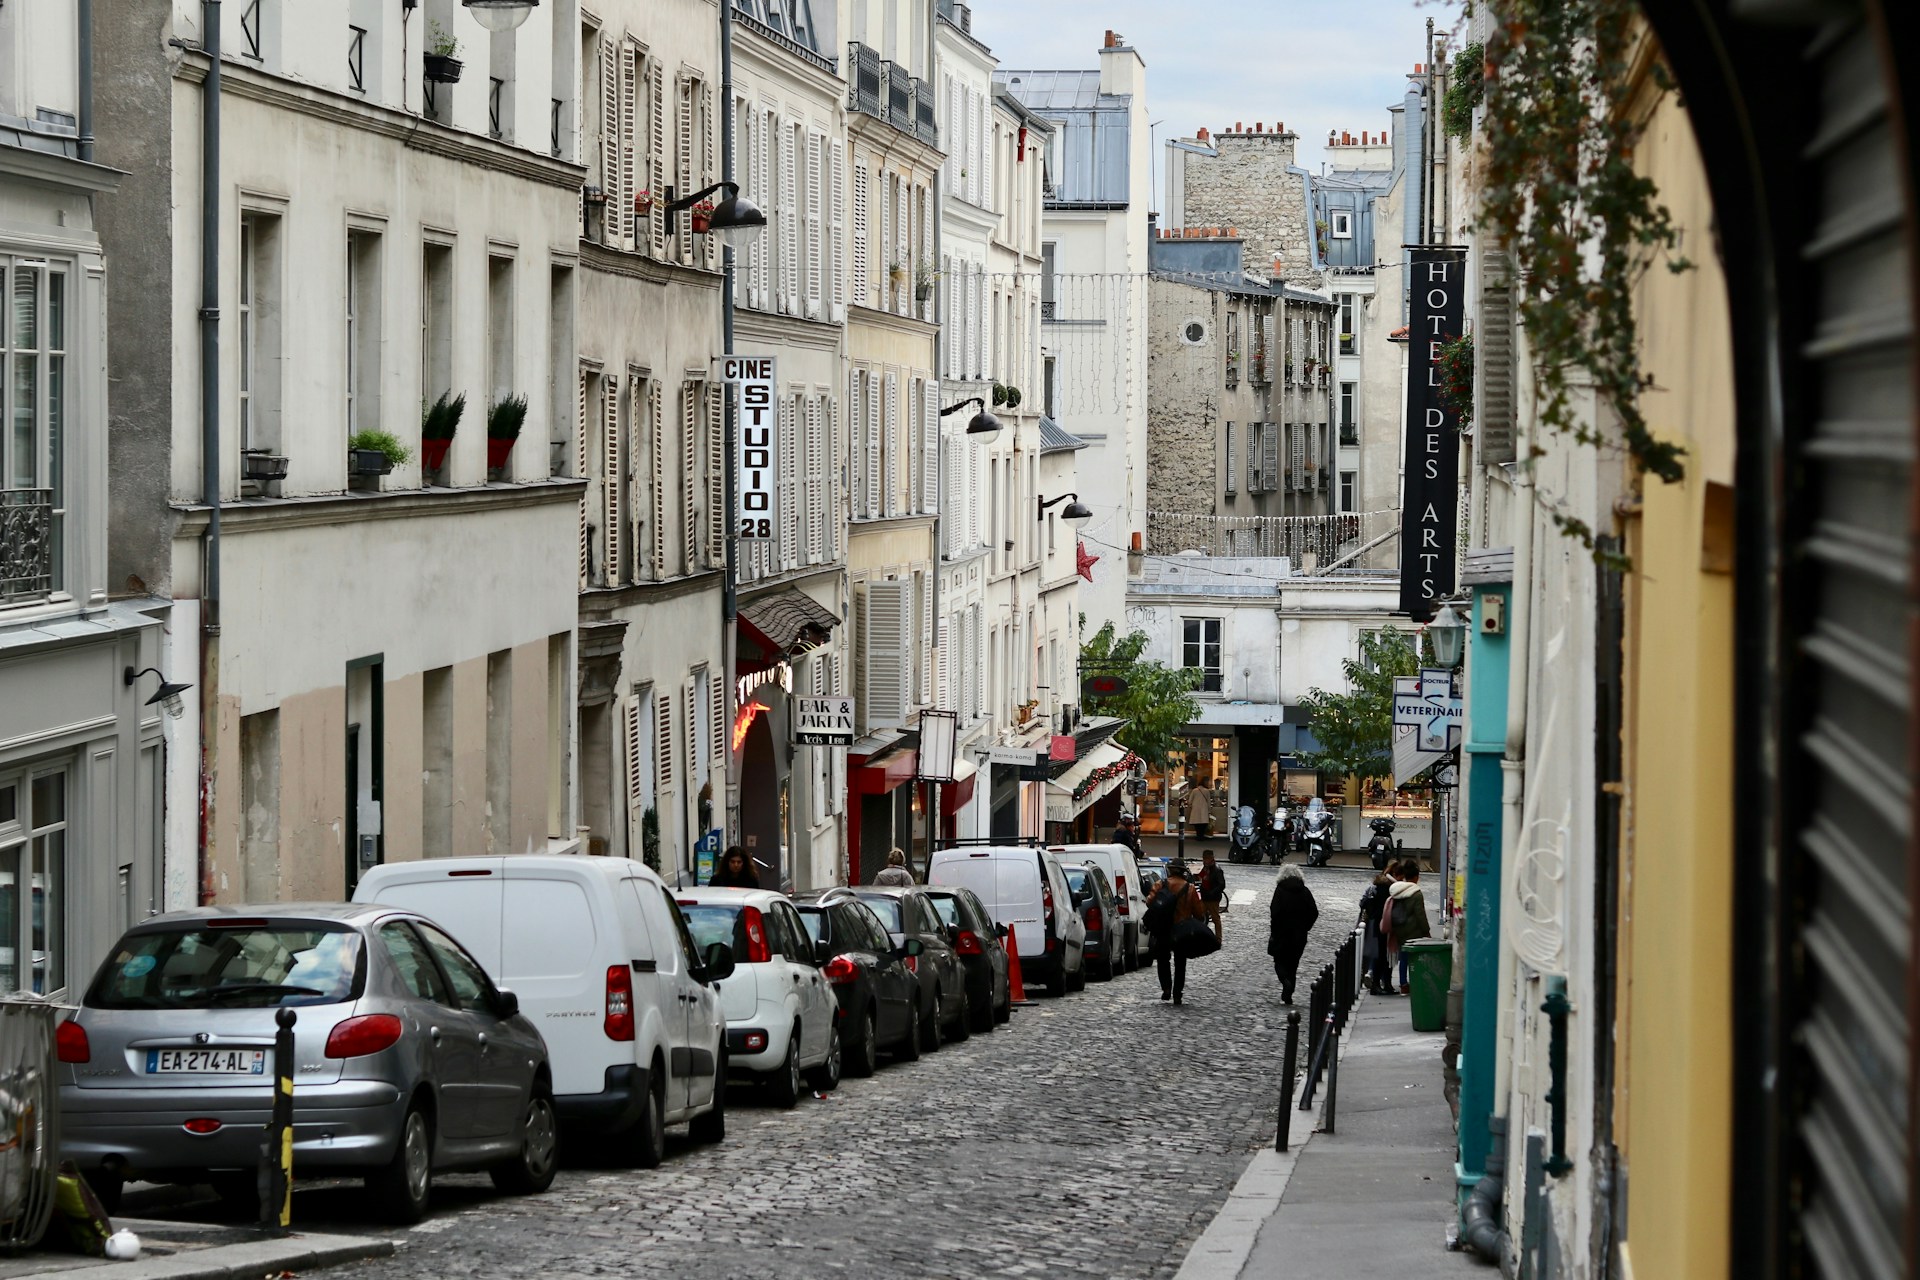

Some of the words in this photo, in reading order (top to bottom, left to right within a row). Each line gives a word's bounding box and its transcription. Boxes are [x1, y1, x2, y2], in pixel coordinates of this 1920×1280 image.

[1427, 262, 1448, 387] HOTEL
[725, 360, 771, 379] CINE
[744, 385, 769, 511] STUDIO
[1425, 408, 1444, 479] DES
[741, 519, 771, 538] 28
[1419, 502, 1441, 599] ARTS
[800, 700, 830, 713] BAR
[840, 702, 850, 714] &
[796, 715, 852, 728] JARDIN
[707, 835, 718, 851] P
[160, 1051, 248, 1071] EA-274-AL
[252, 1062, 262, 1073] 75
[300, 1064, 322, 1073] 206
